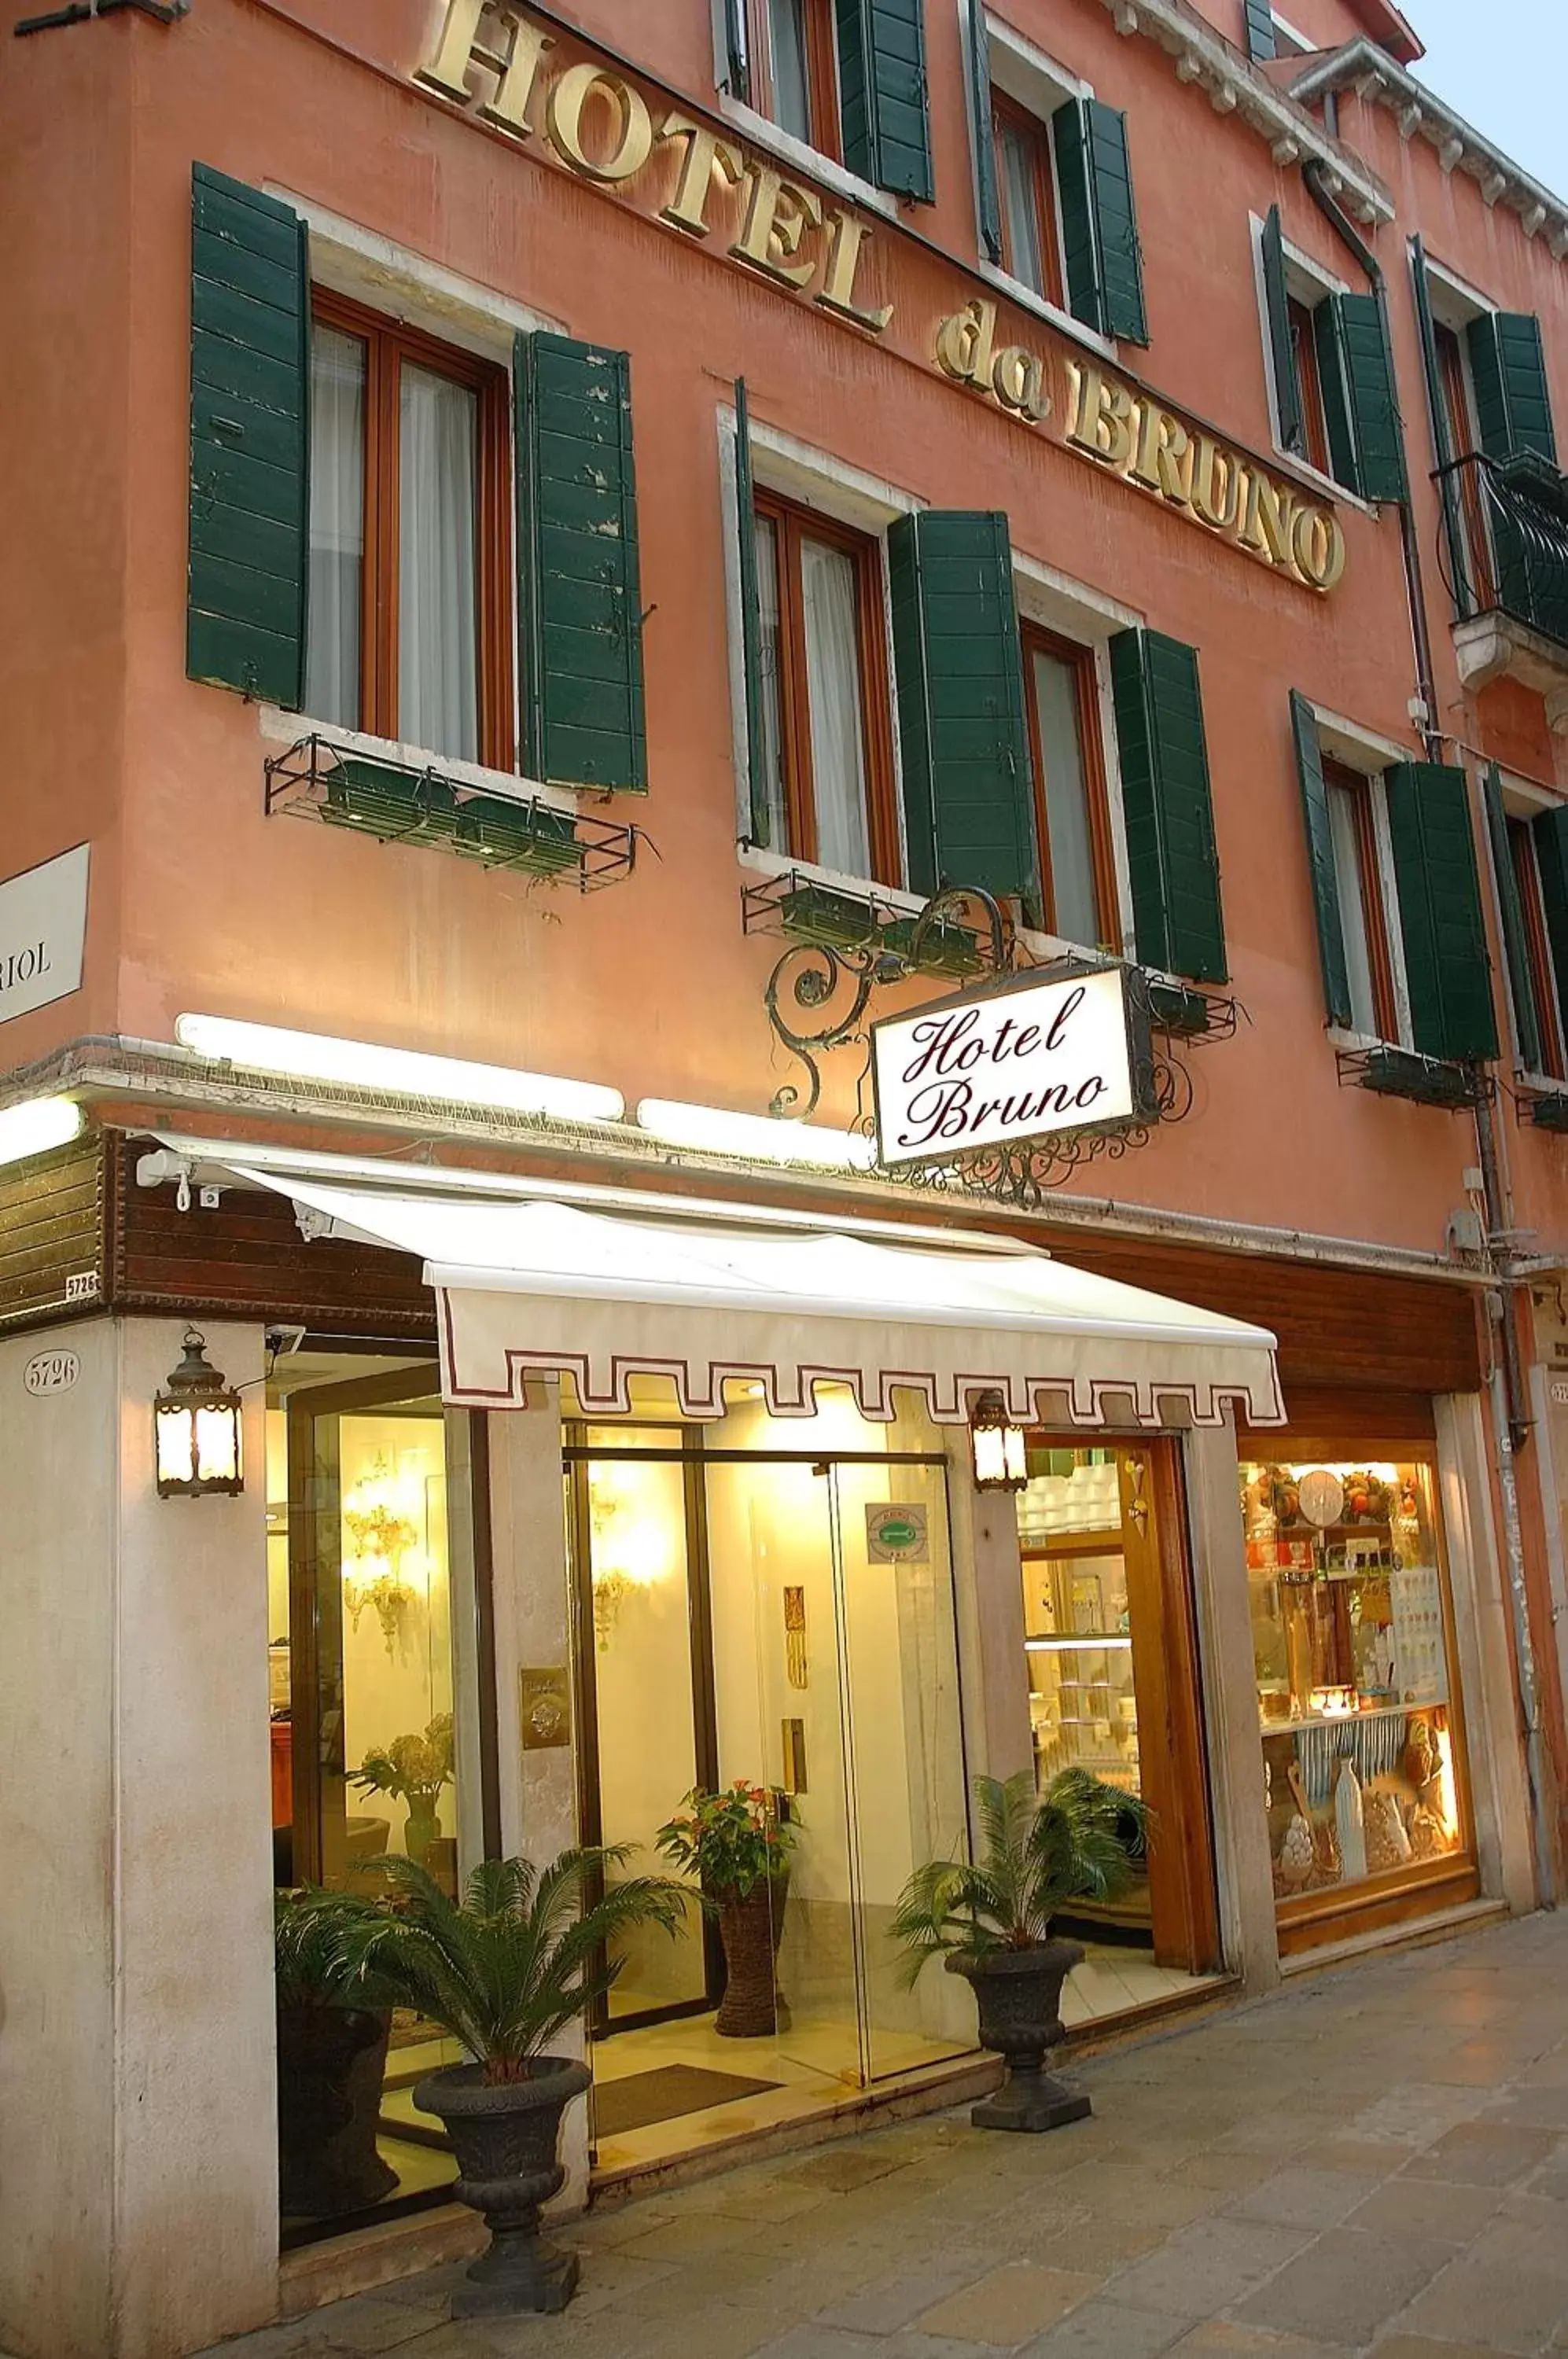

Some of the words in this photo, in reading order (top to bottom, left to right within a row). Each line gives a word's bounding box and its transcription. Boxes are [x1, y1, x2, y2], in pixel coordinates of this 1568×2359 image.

[411, 0, 894, 334] HOTEL
[935, 298, 1051, 423] da
[1066, 359, 1345, 590] BRUNO
[902, 986, 1087, 1083] Hotel
[897, 1075, 1109, 1146] Bruno
[30, 1356, 75, 1387] 5726
